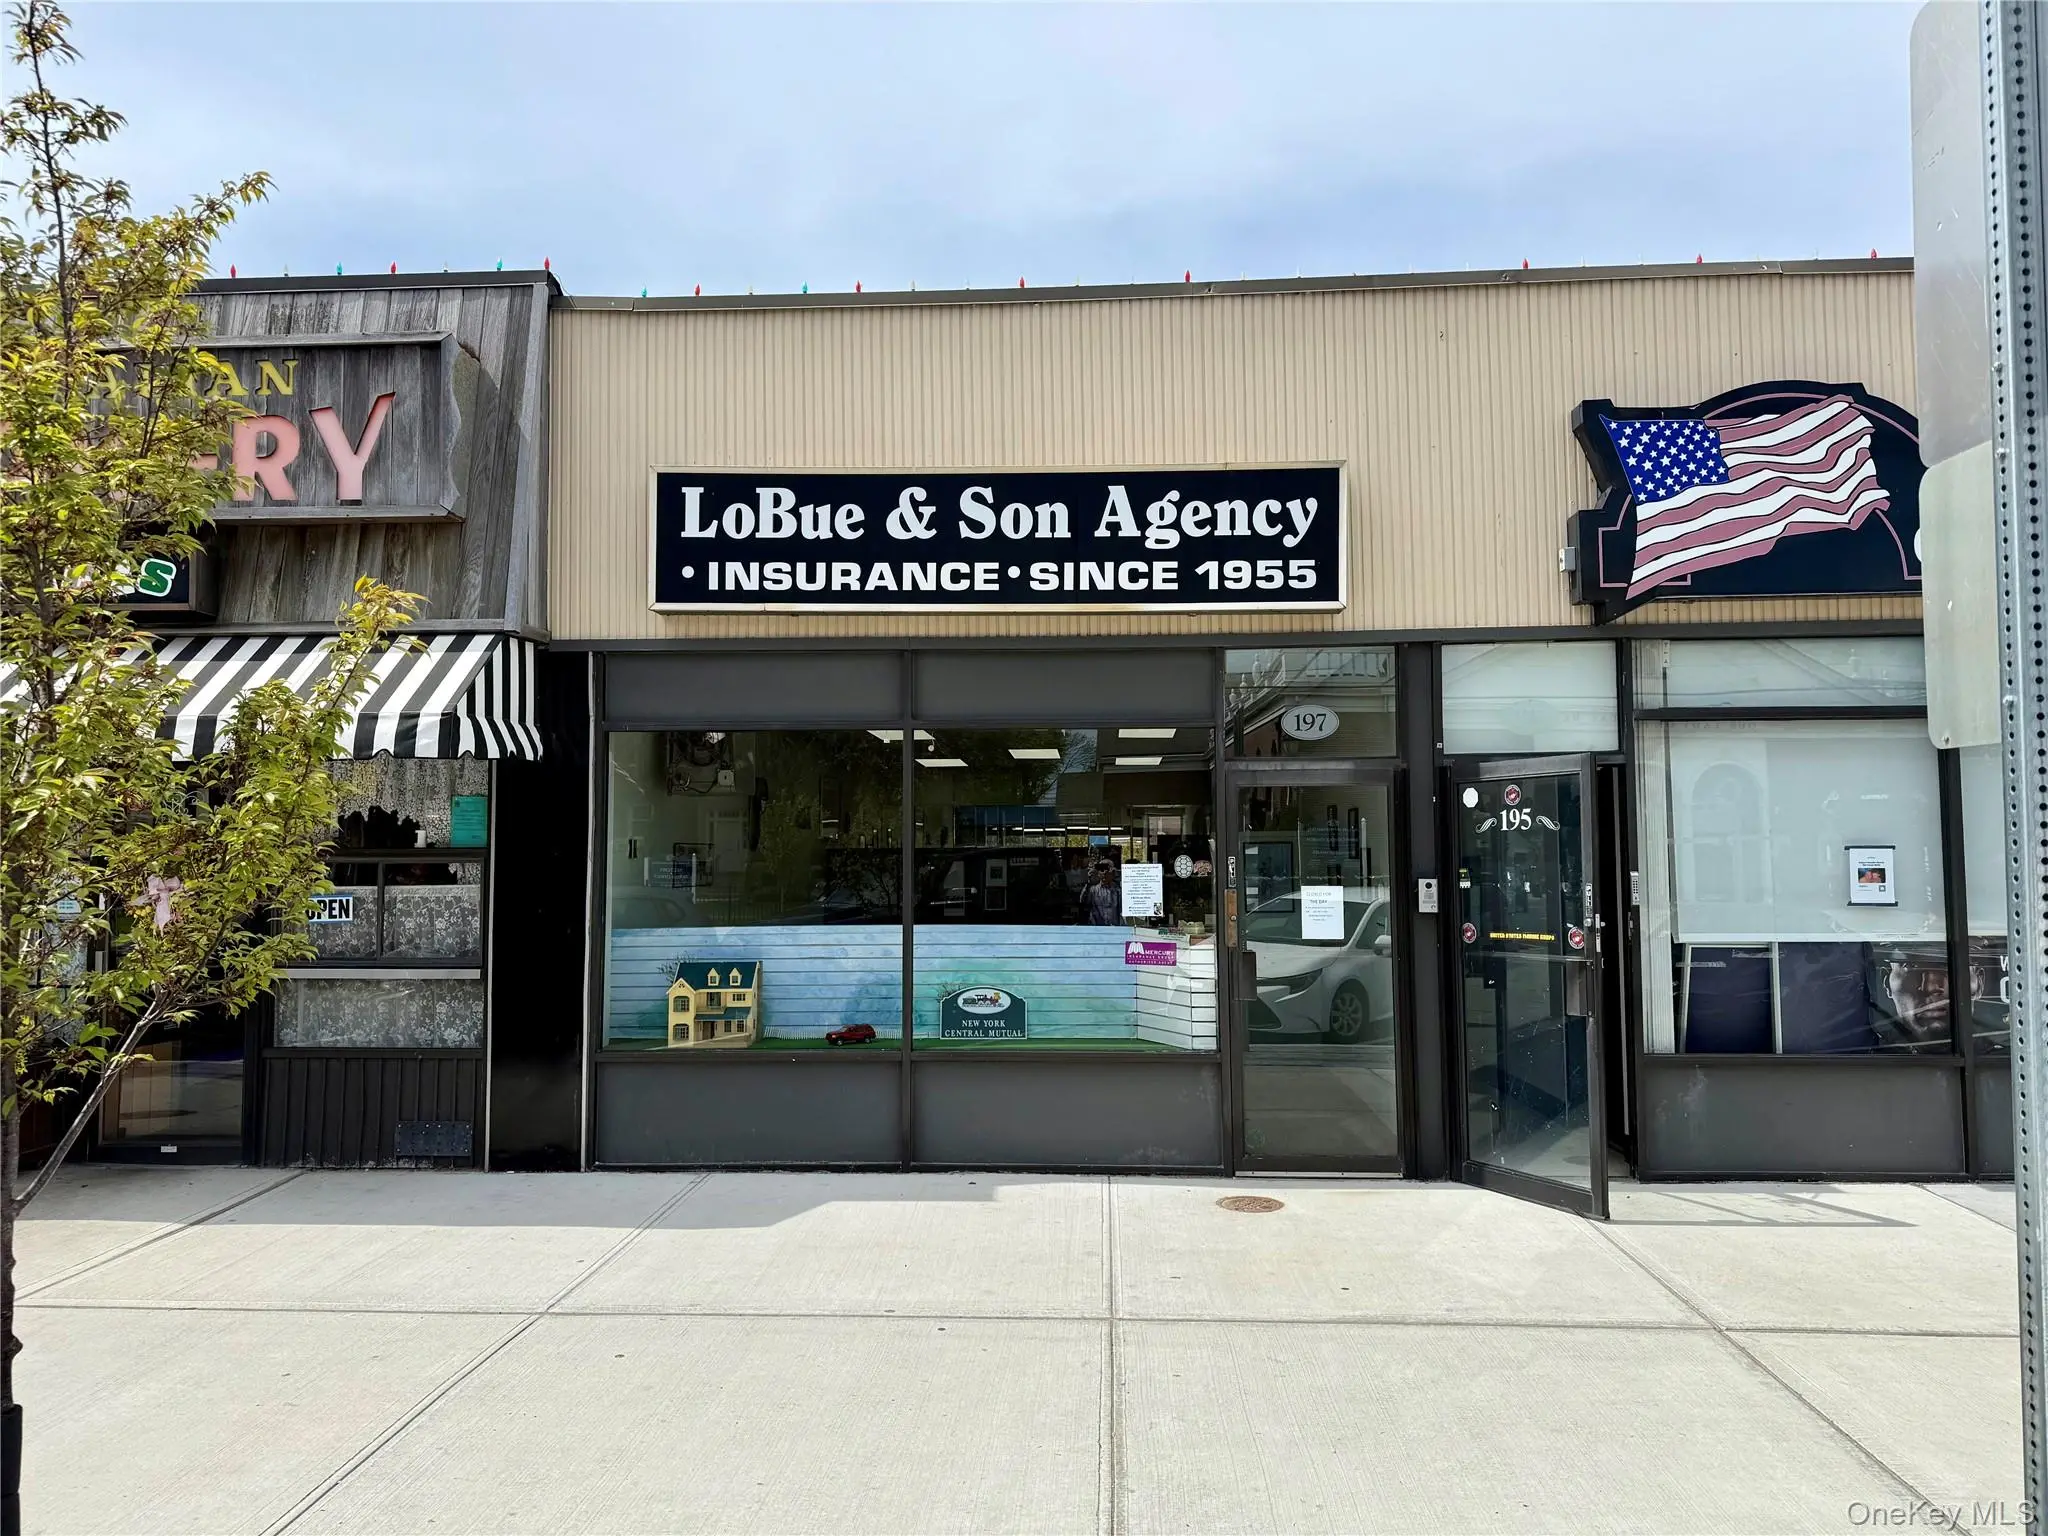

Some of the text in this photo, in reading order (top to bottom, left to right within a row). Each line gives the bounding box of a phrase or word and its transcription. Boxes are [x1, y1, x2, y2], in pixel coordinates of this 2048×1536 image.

[681, 485, 1318, 550] LoBue & Son Agency
[708, 559, 1317, 591] INSURANCE SINCE 1955
[1294, 713, 1327, 732] 197
[1499, 808, 1532, 831] 195
[945, 1029, 1023, 1037] CENTRAL MUTUAL
[962, 1019, 1006, 1028] NEW YORK
